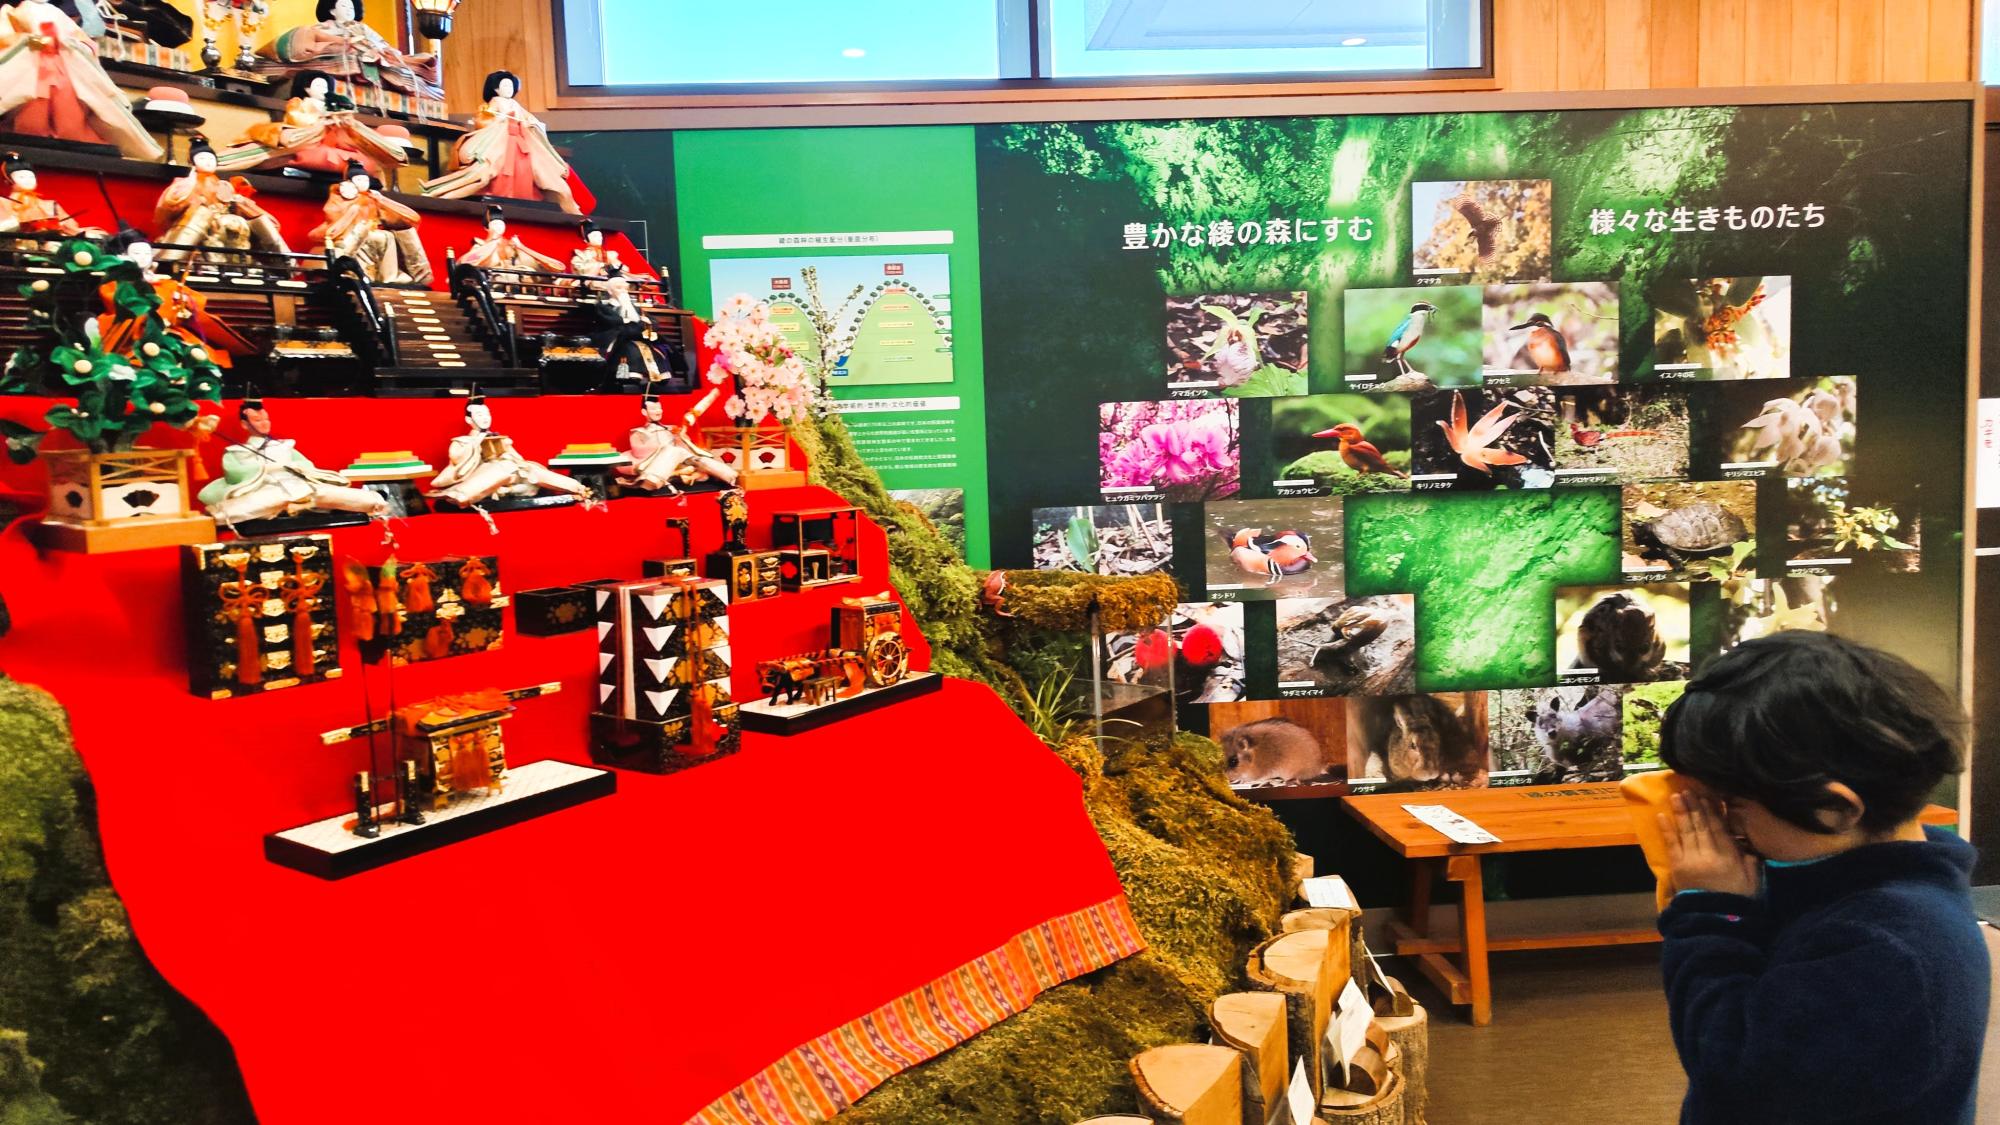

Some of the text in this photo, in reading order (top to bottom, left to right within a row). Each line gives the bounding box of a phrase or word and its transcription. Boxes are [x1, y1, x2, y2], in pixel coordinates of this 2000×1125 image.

[1588, 203, 1828, 237] 様々な生きものたち
[1122, 216, 1374, 252] 豊かな綾の森にすむ
[1416, 277, 1442, 285] クマタカ
[1487, 377, 1512, 385] カワセミ
[1416, 481, 1453, 490] キリノミタケ
[1276, 486, 1320, 496] アカショウビン
[1211, 592, 1236, 600] オシドリ
[1352, 785, 1377, 793] ノウサギ
